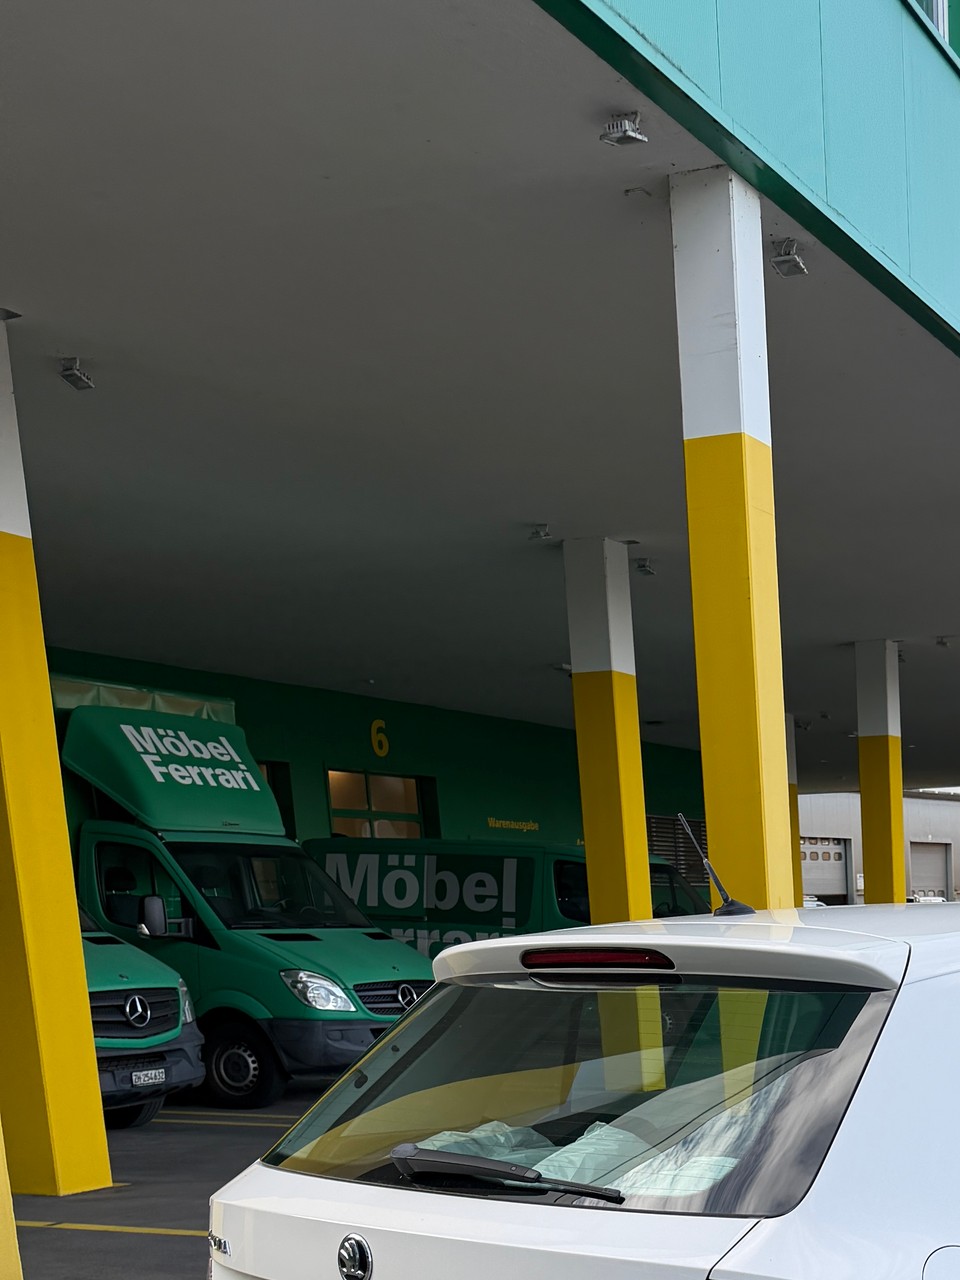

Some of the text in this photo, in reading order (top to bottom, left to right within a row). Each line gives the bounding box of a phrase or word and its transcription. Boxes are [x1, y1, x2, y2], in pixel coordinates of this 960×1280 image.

[120, 724, 242, 763] Möbel
[371, 719, 389, 757] 6
[140, 754, 261, 791] Ferrari
[487, 817, 539, 832] Warenausgabe
[325, 853, 517, 912] Möbel
